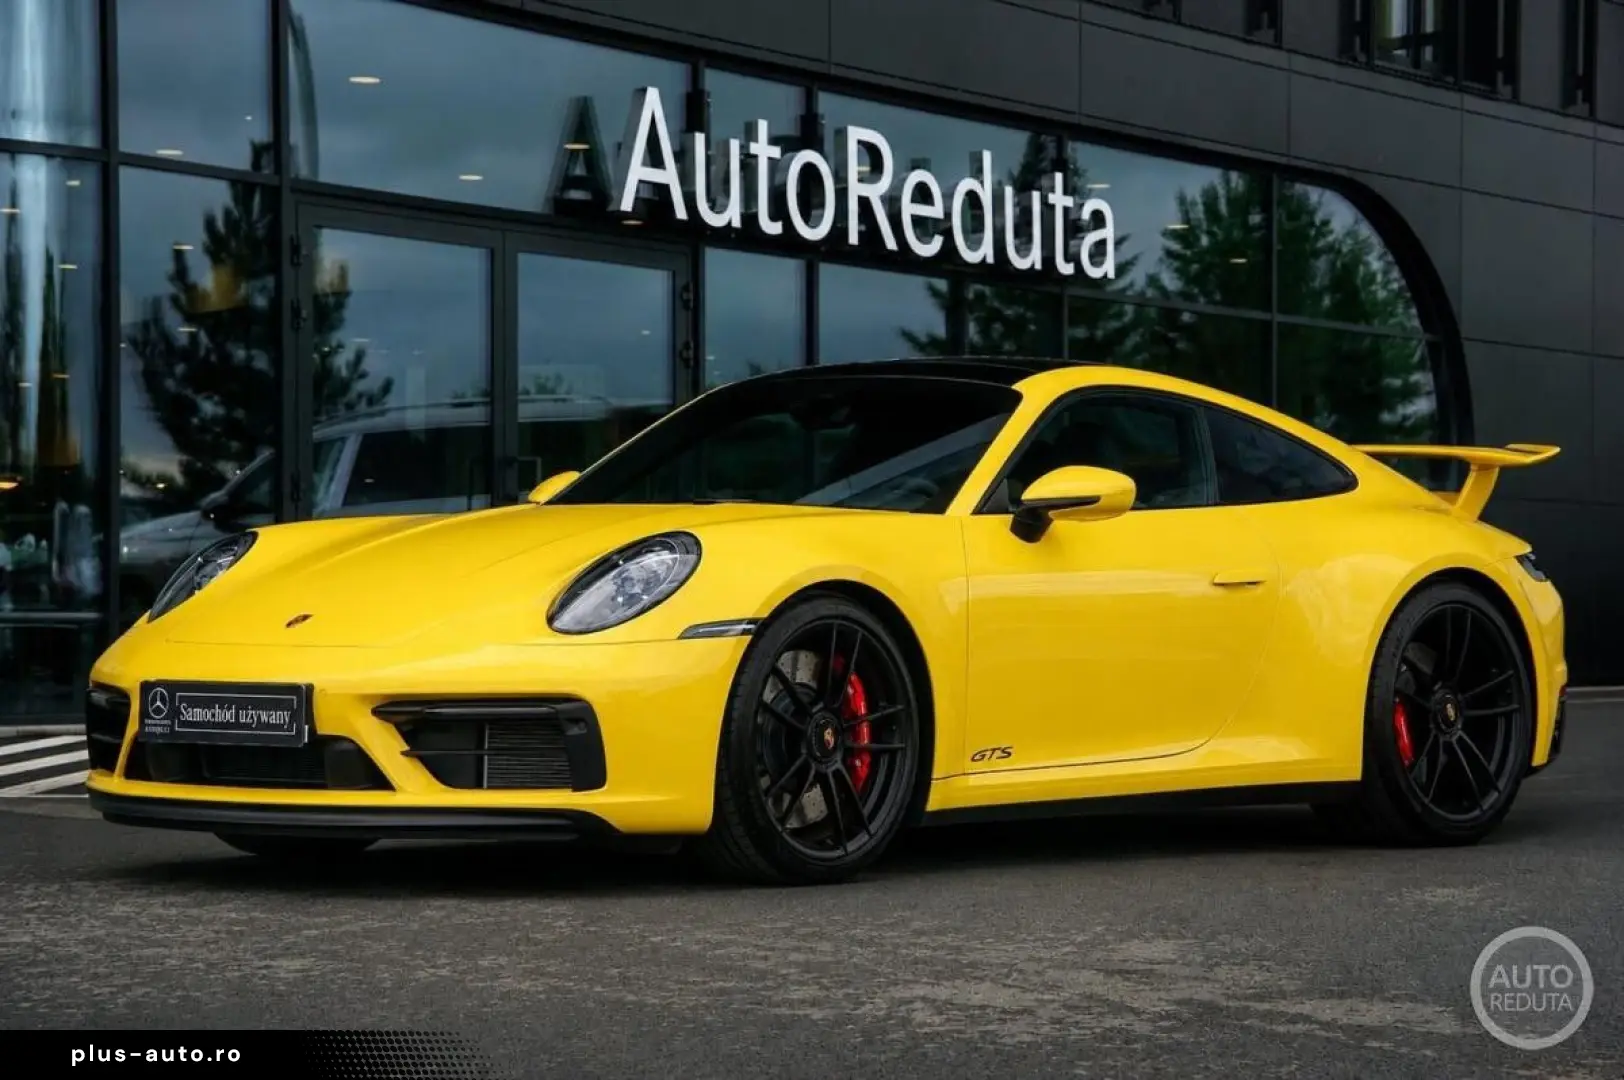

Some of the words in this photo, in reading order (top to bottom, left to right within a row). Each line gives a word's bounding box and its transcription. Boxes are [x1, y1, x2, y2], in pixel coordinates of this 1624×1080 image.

[620, 86, 1115, 279] AutoReduta
[180, 703, 235, 723] Samochód
[238, 705, 292, 728] używany
[971, 746, 1013, 762] GTS
